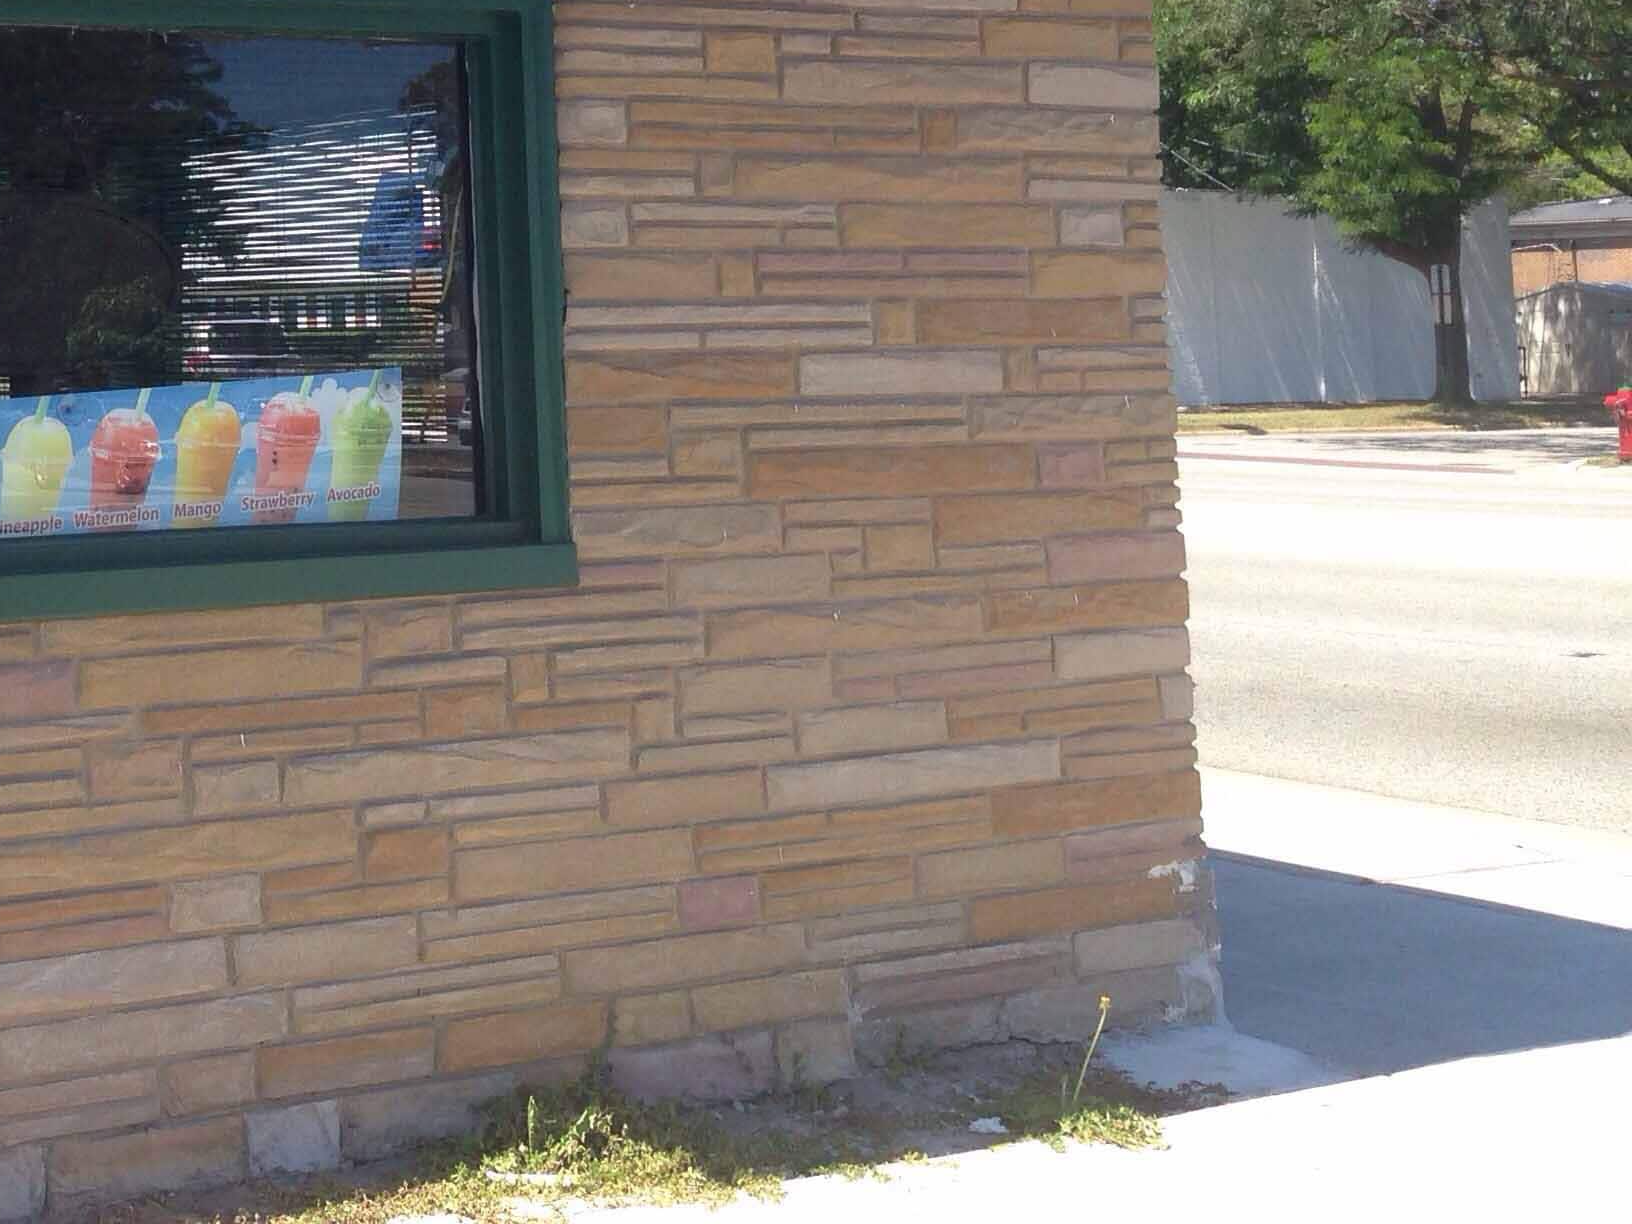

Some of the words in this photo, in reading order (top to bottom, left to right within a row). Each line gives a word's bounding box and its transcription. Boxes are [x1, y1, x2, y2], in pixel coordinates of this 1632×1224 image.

[74, 505, 161, 528] Watermelon
[174, 500, 222, 519] Mango
[241, 491, 315, 513] Strawberry
[327, 482, 381, 503] Avocado
